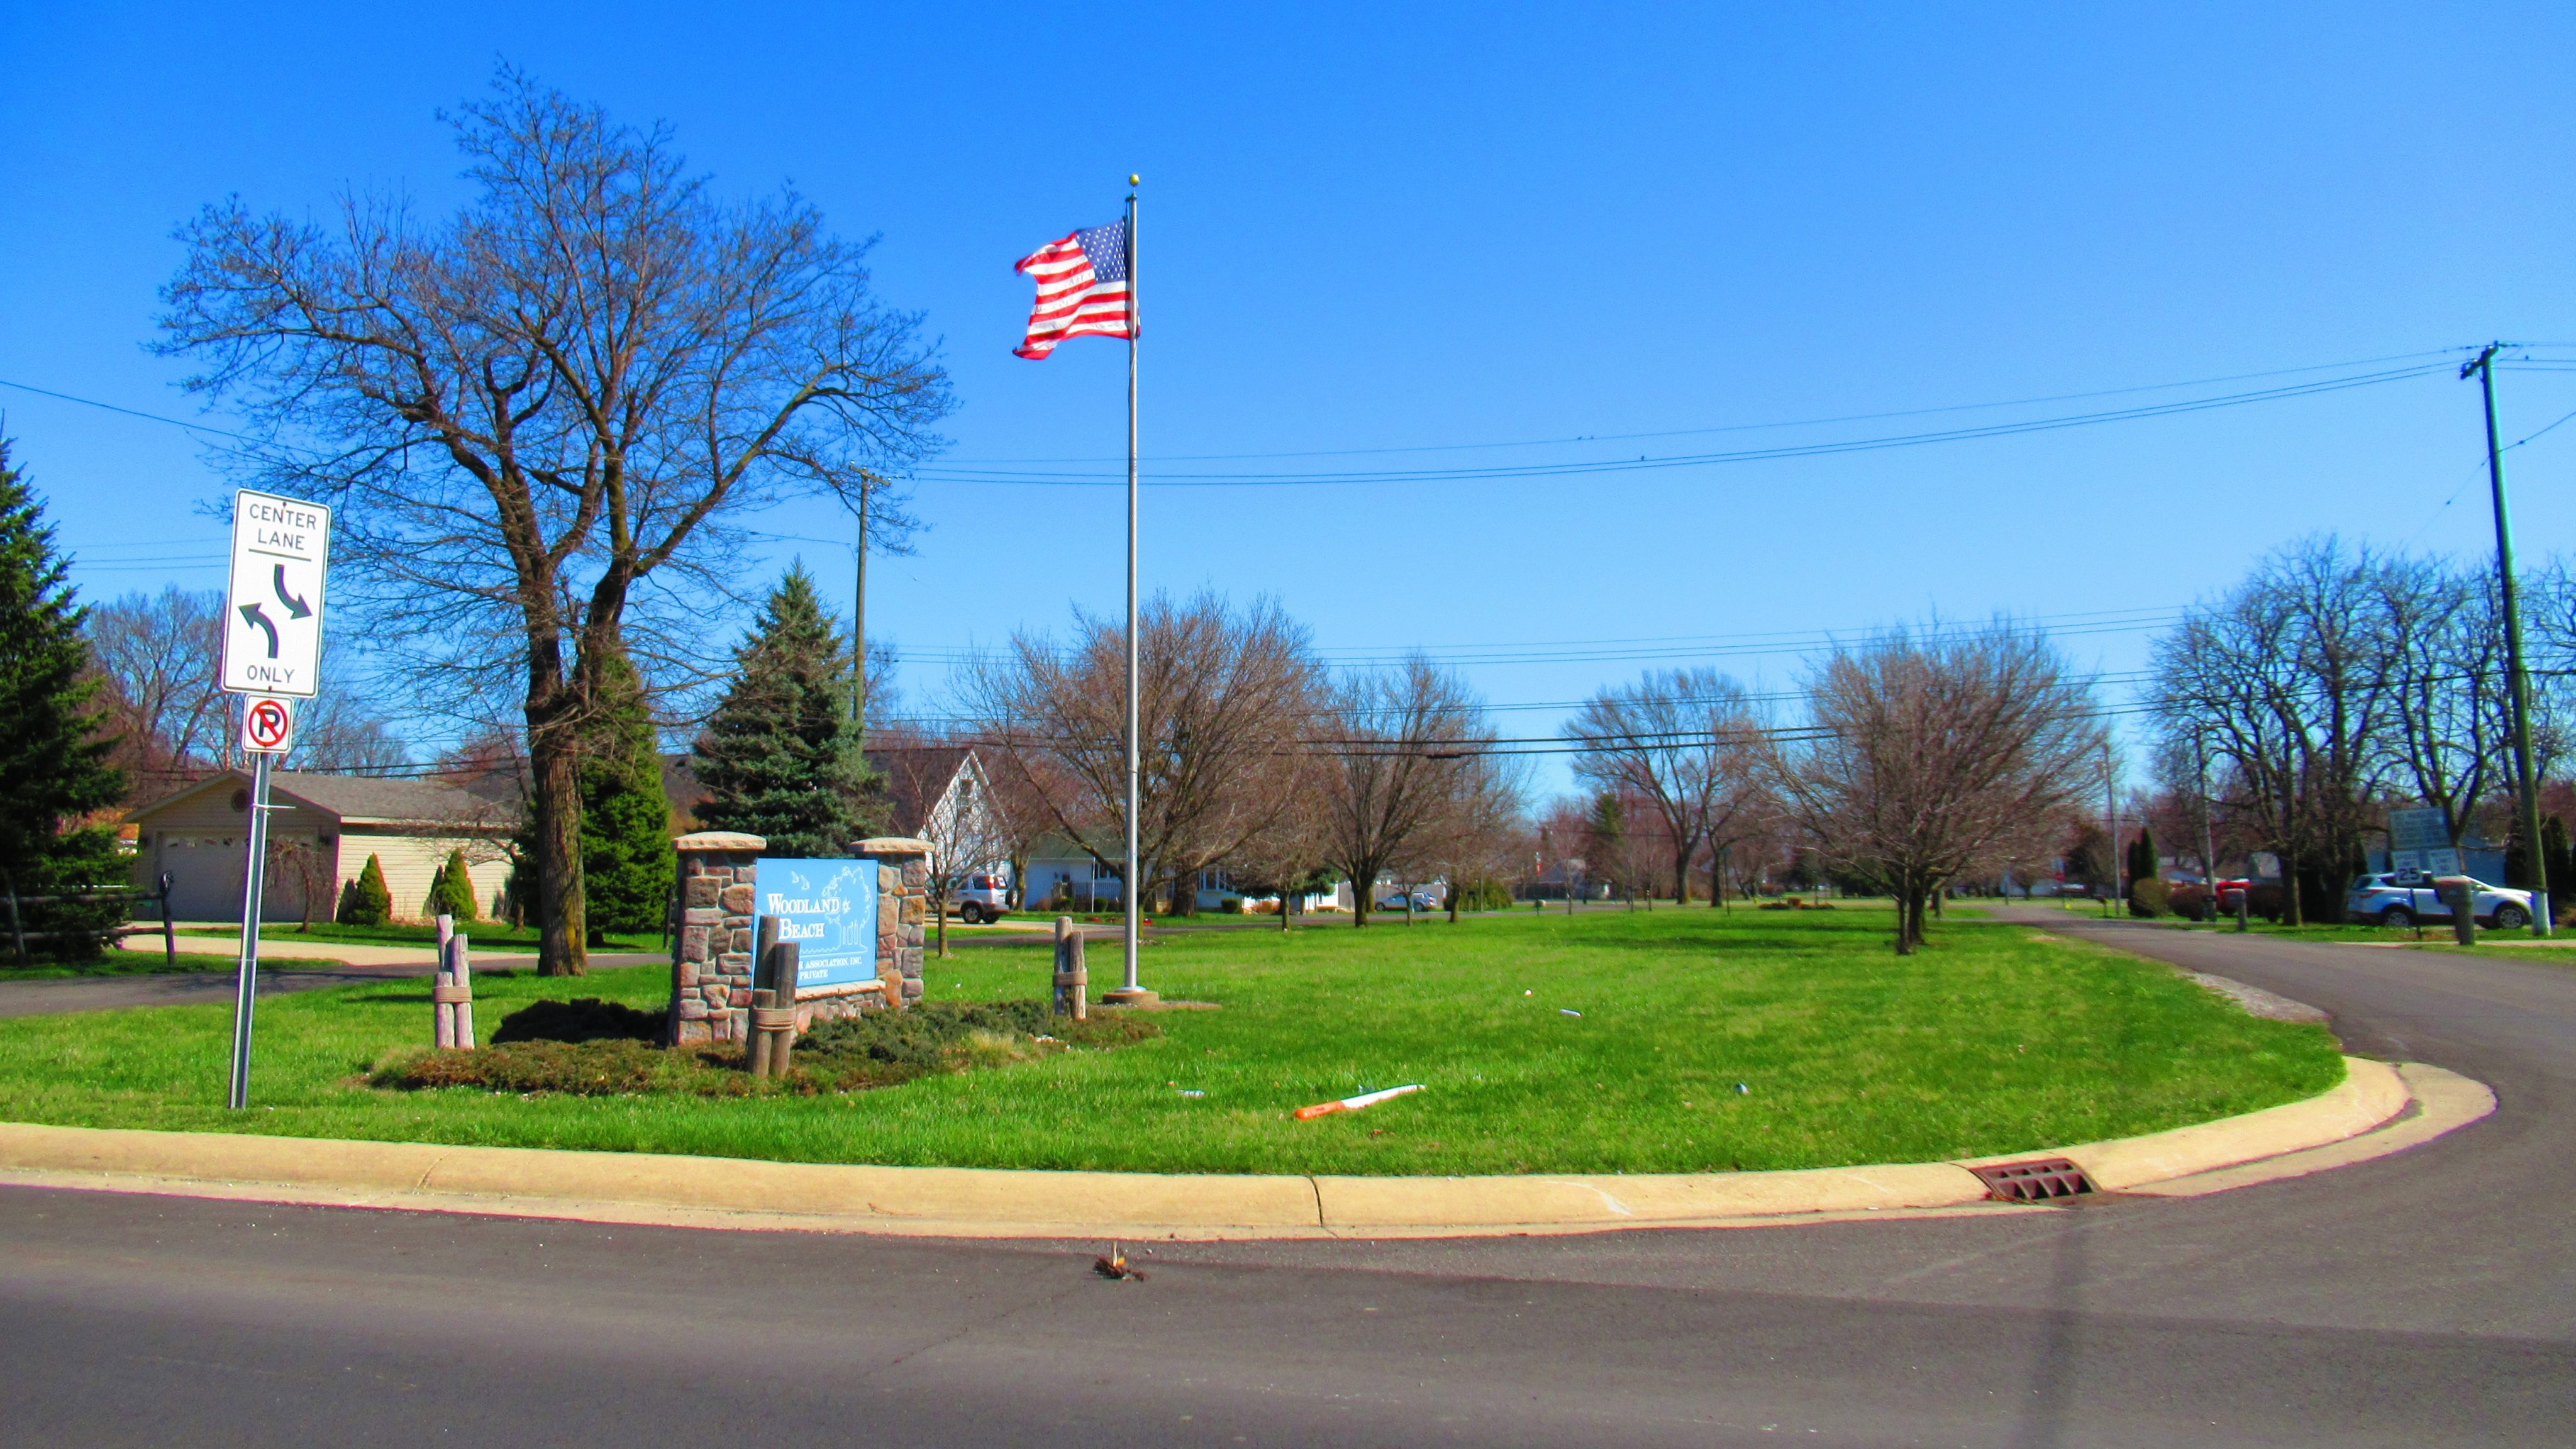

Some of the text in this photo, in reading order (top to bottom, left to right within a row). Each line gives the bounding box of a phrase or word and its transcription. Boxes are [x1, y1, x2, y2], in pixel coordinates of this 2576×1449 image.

[250, 504, 316, 530] CENTER
[258, 528, 305, 550] LANE
[247, 665, 295, 683] ONLY
[2398, 868, 2420, 880] 25
[799, 969, 828, 980] PRIVATE
